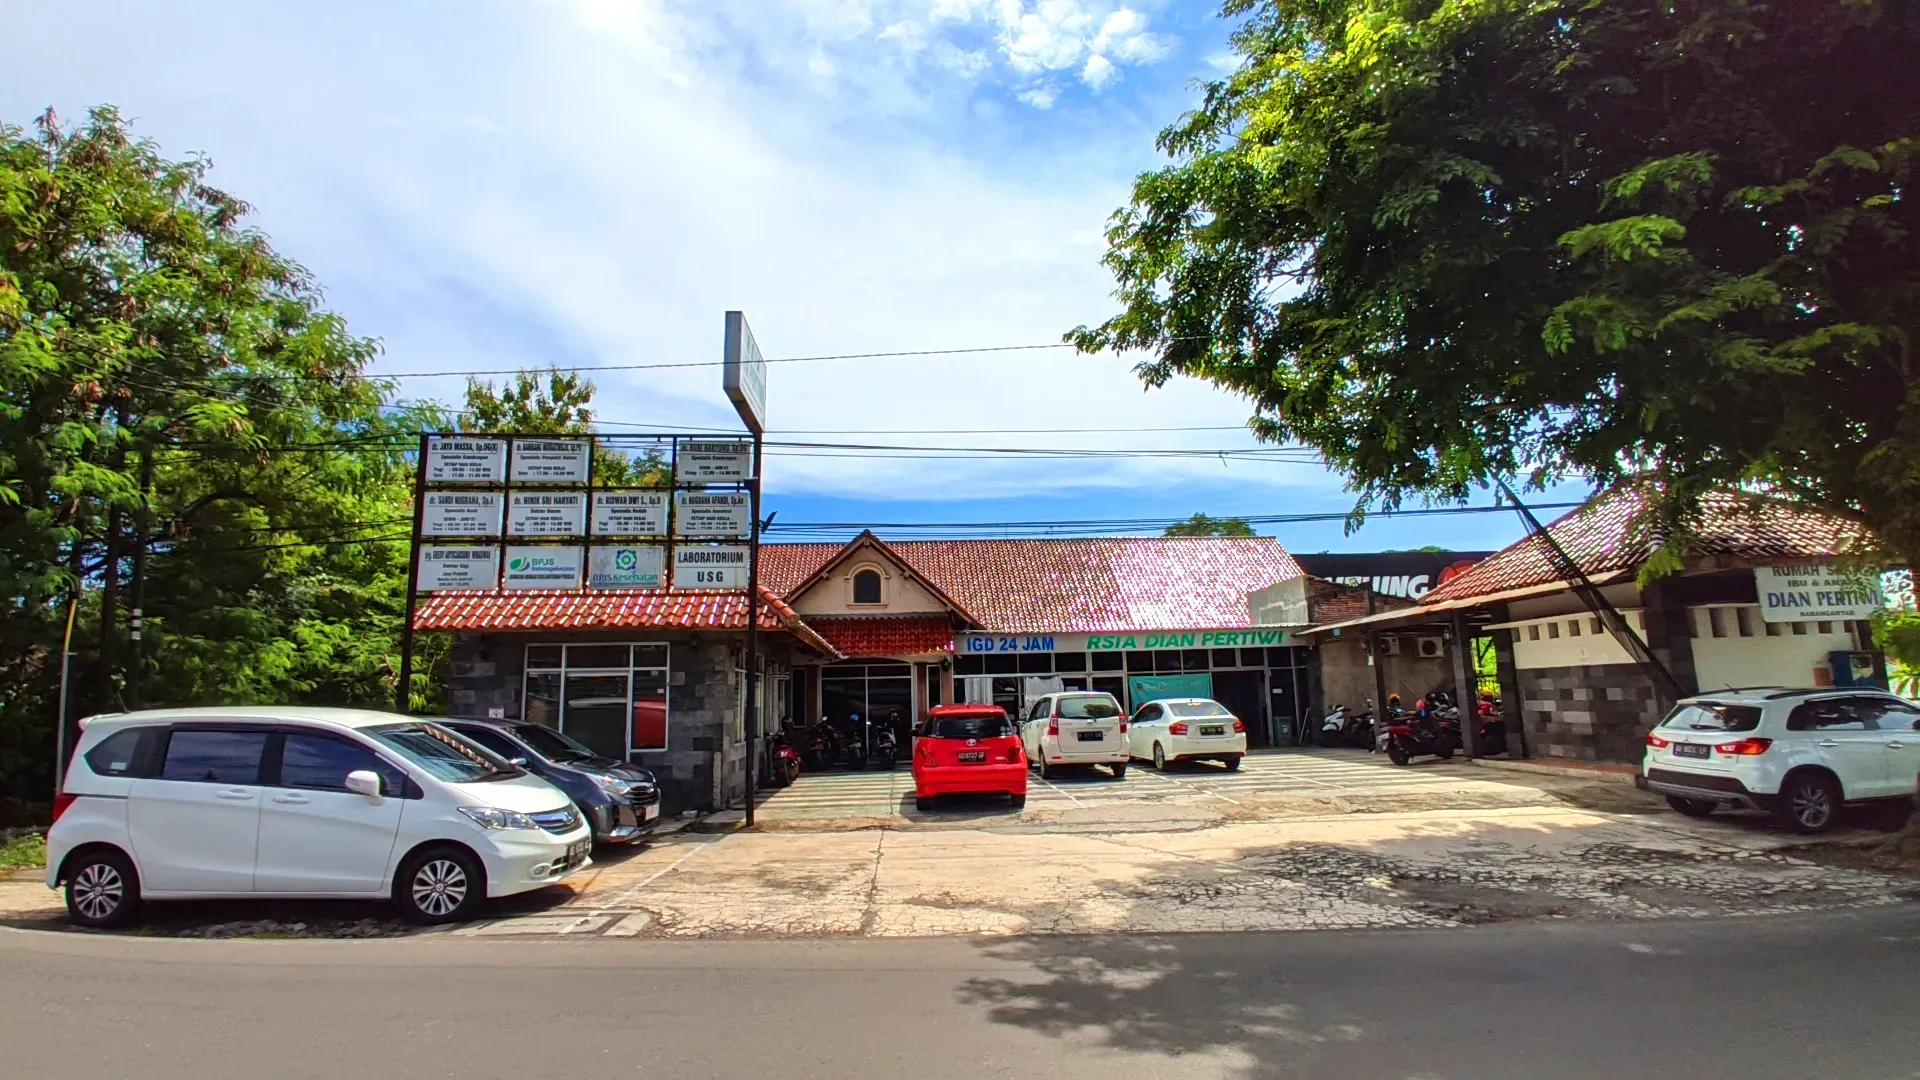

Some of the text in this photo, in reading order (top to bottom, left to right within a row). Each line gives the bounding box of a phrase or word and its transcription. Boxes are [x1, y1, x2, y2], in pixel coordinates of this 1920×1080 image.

[542, 496, 553, 505] SRI
[554, 496, 579, 505] HARYATI
[531, 558, 555, 567] BPJS
[678, 551, 744, 564] LABORATORIUM
[697, 571, 724, 583] USG
[1772, 565, 1819, 577] RUMAH
[592, 573, 659, 582] BPJS Kesehatan
[1788, 579, 1808, 587] IBU
[1811, 579, 1821, 587] &
[1768, 591, 1811, 608] DIAN
[967, 636, 1055, 652] IGD 24 JAM
[1086, 631, 1285, 650] RSIA DIAN PERTIWI
